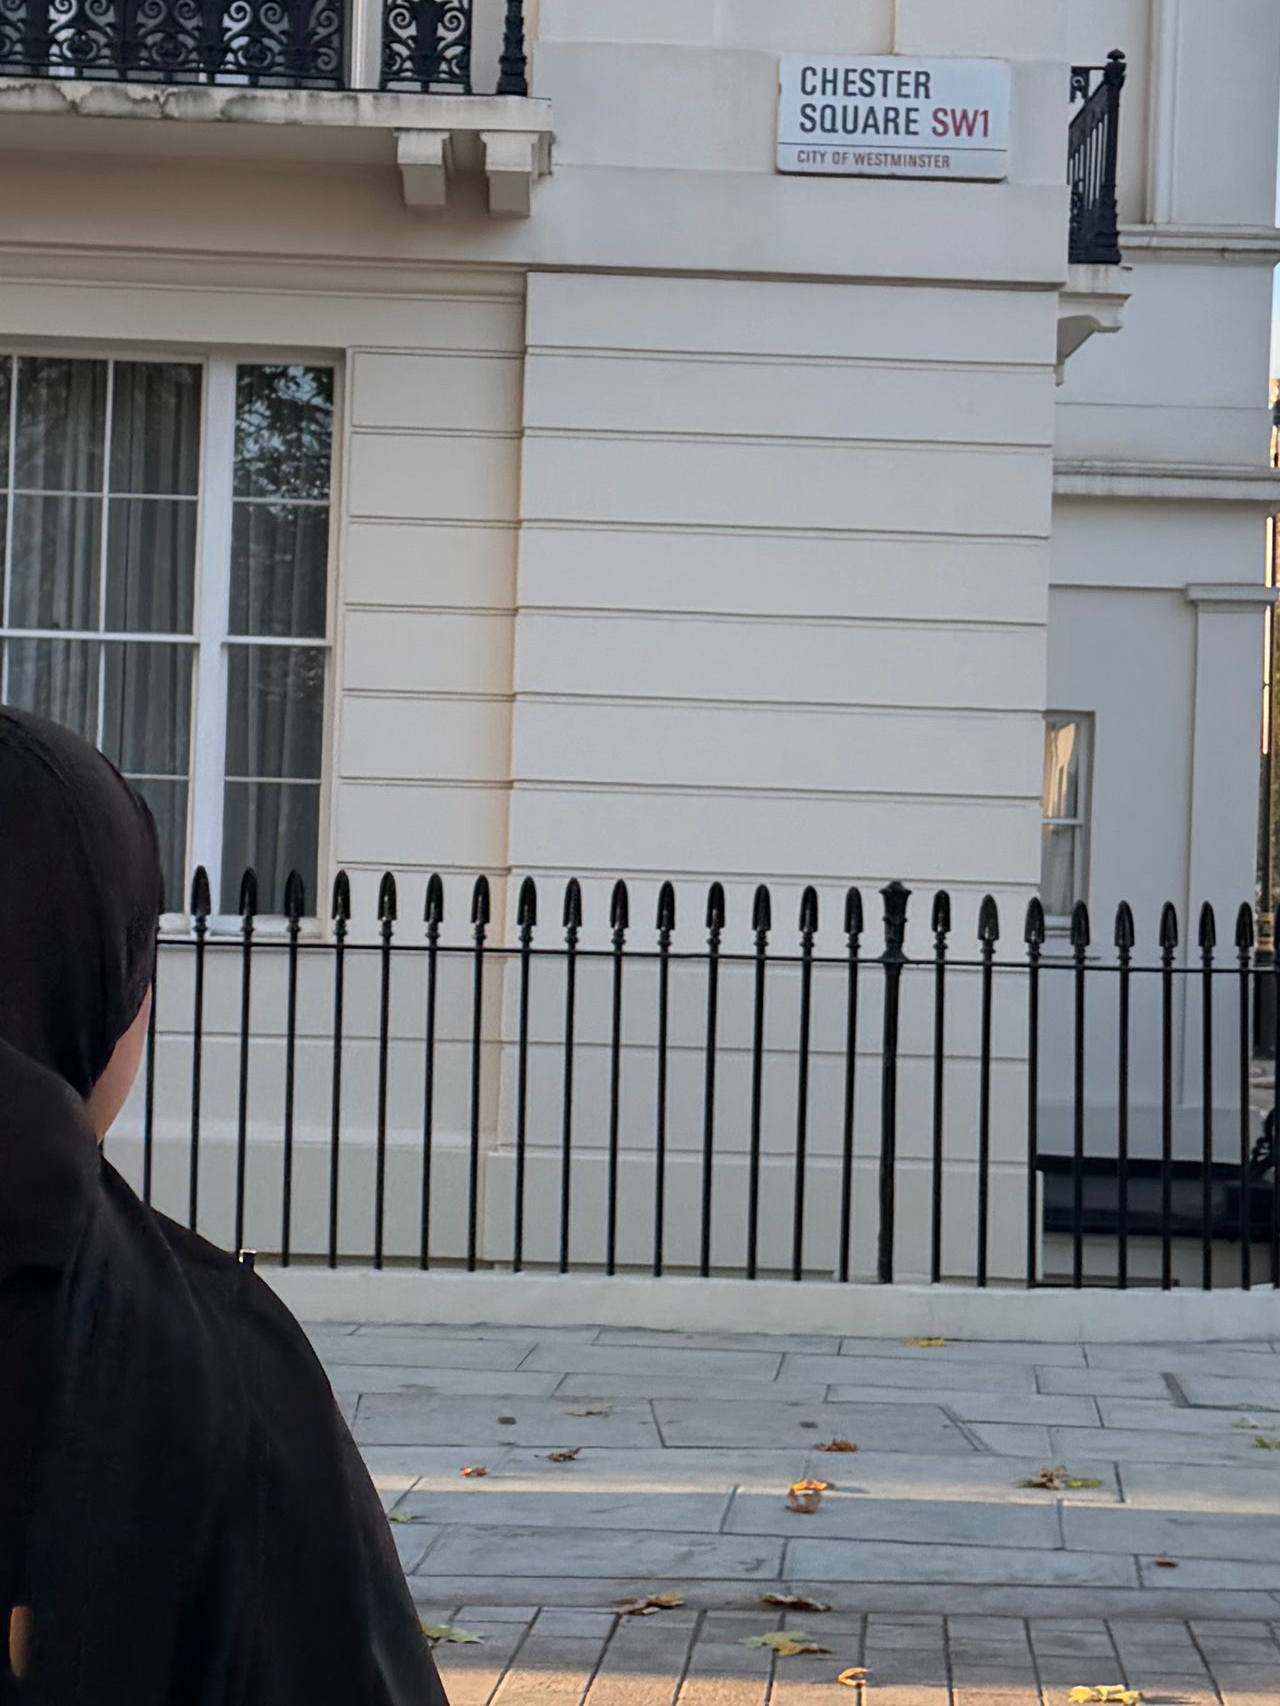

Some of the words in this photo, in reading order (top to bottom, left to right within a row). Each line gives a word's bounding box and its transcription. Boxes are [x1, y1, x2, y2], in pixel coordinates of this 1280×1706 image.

[799, 66, 931, 99] CHESTER
[799, 103, 920, 136] SQUARE
[931, 107, 990, 138] SW1
[797, 150, 826, 165] CITY
[831, 151, 850, 166] OF
[852, 152, 951, 169] WESTMINSTER
